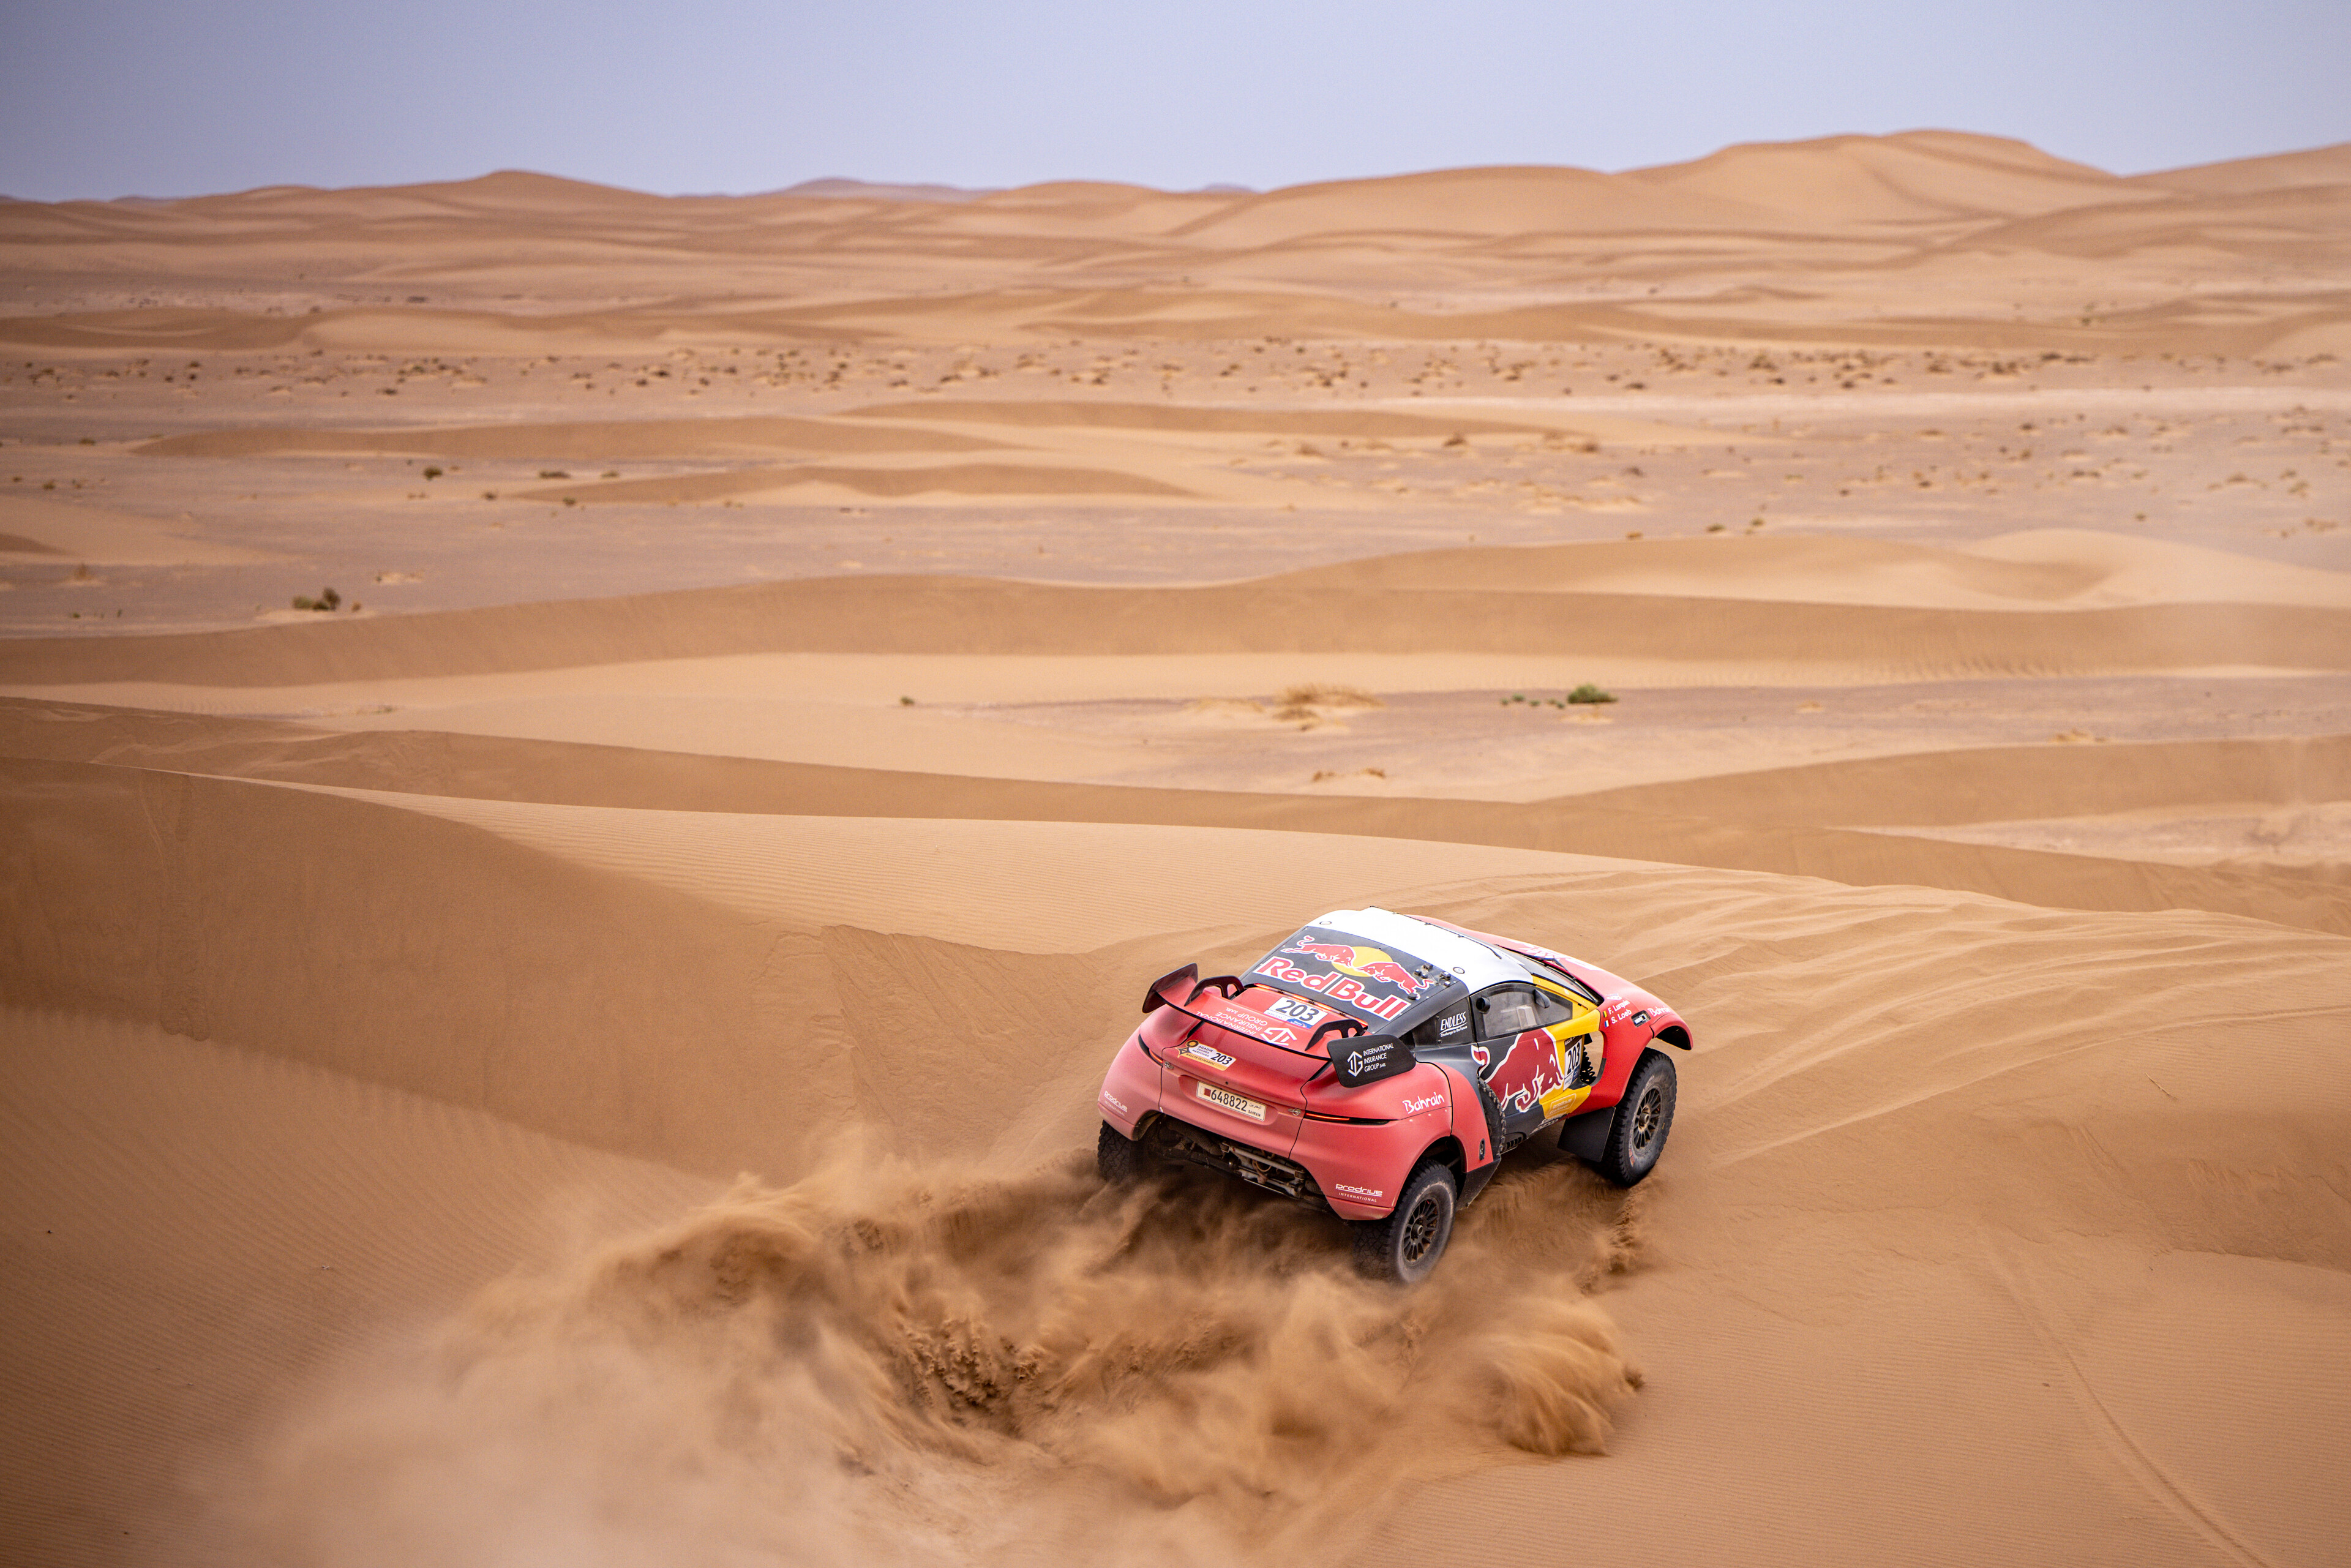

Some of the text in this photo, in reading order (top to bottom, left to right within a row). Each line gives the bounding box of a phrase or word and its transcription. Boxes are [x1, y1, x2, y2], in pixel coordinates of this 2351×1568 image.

[1253, 956, 1411, 1021] Red Bull
[1275, 1000, 1319, 1021] 203
[1613, 1000, 1630, 1011] Lurquin
[1215, 1011, 1261, 1032] INSURANCE
[1237, 1012, 1267, 1026] GROUP
[1440, 1011, 1466, 1031] ENDLESS
[1618, 1009, 1632, 1020] Loeb
[1196, 1011, 1256, 1035] INTERNATIONAL
[1363, 1043, 1393, 1056] INTERNATIONAL
[1210, 1052, 1232, 1065] 203
[1363, 1052, 1387, 1064] INSURANCE
[1567, 1042, 1580, 1076] 203
[1364, 1063, 1379, 1072] GROUP
[1210, 1089, 1248, 1112] 648822
[1402, 1092, 1444, 1114] Bahrain
[1335, 1184, 1382, 1196] prodrive
[1339, 1192, 1376, 1202] INTERNATIONAL
